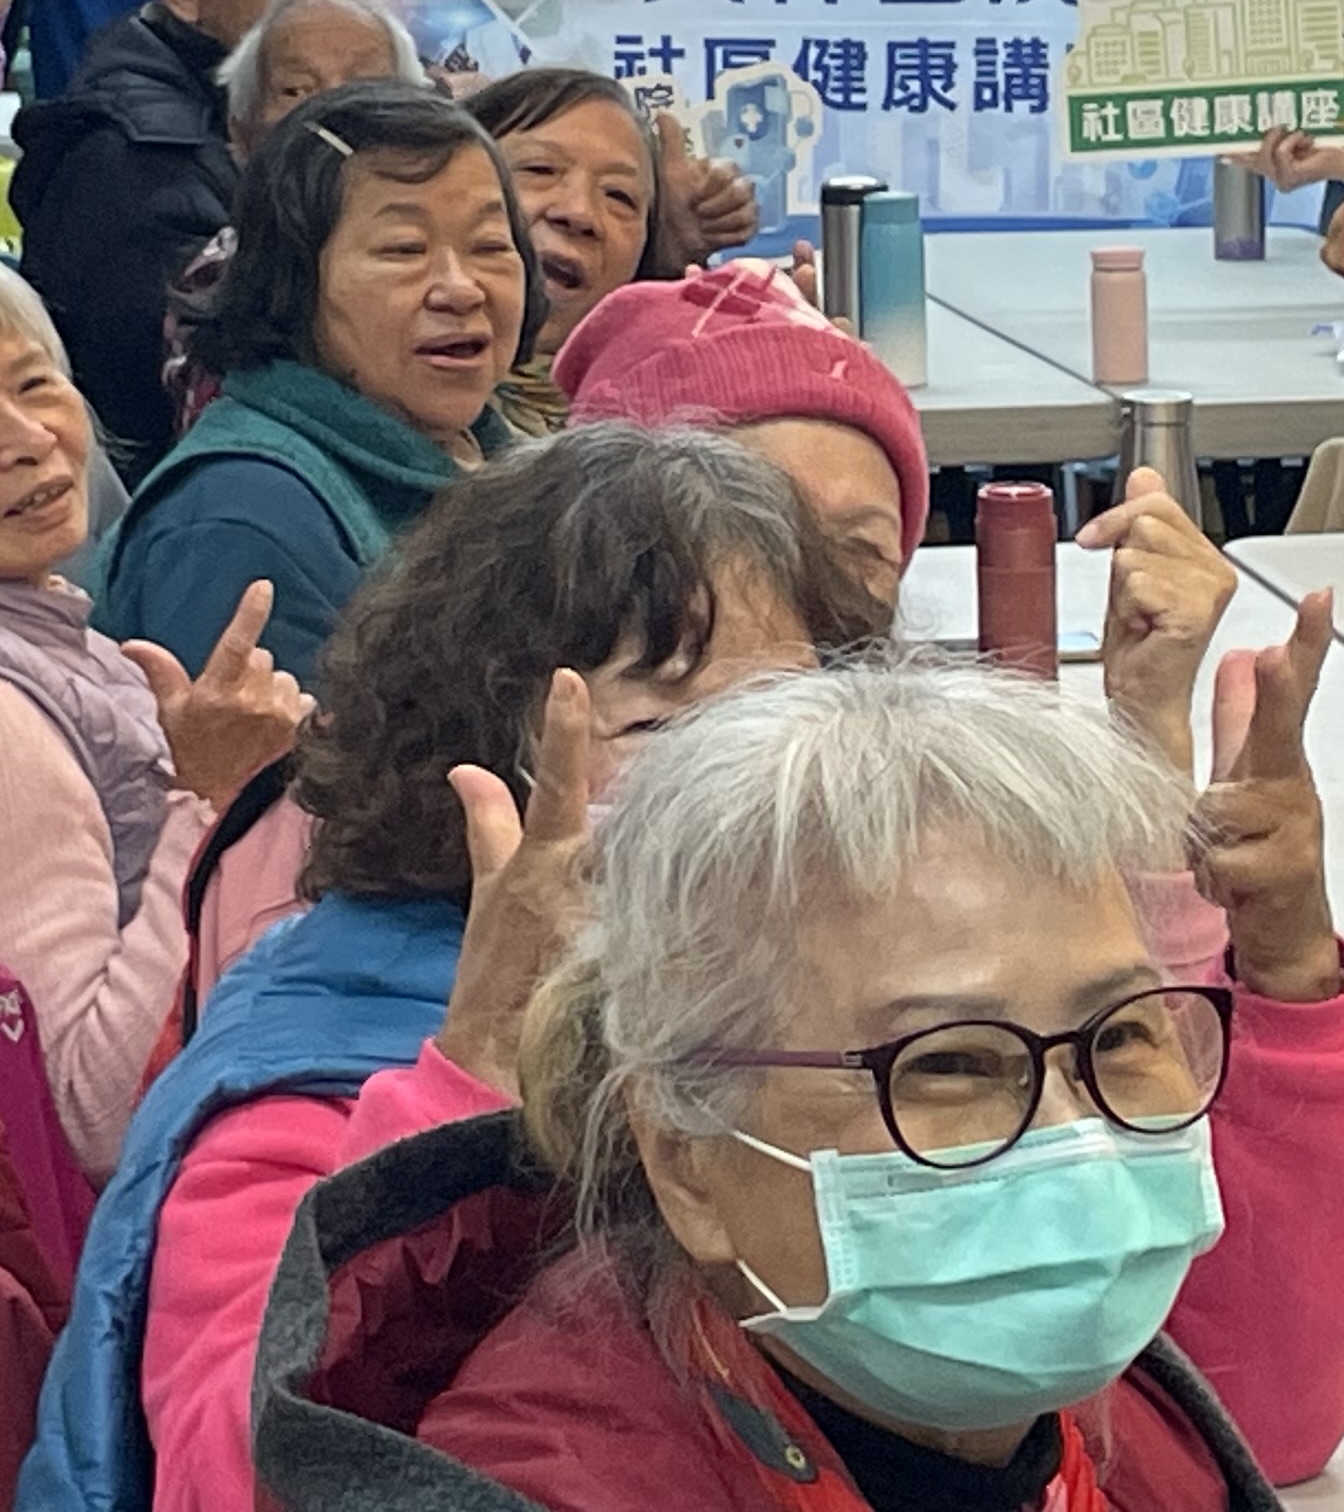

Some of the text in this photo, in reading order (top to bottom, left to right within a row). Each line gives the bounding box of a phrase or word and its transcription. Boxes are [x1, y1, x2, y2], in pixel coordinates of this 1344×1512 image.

[1081, 88, 1340, 144] 社區健康講座
